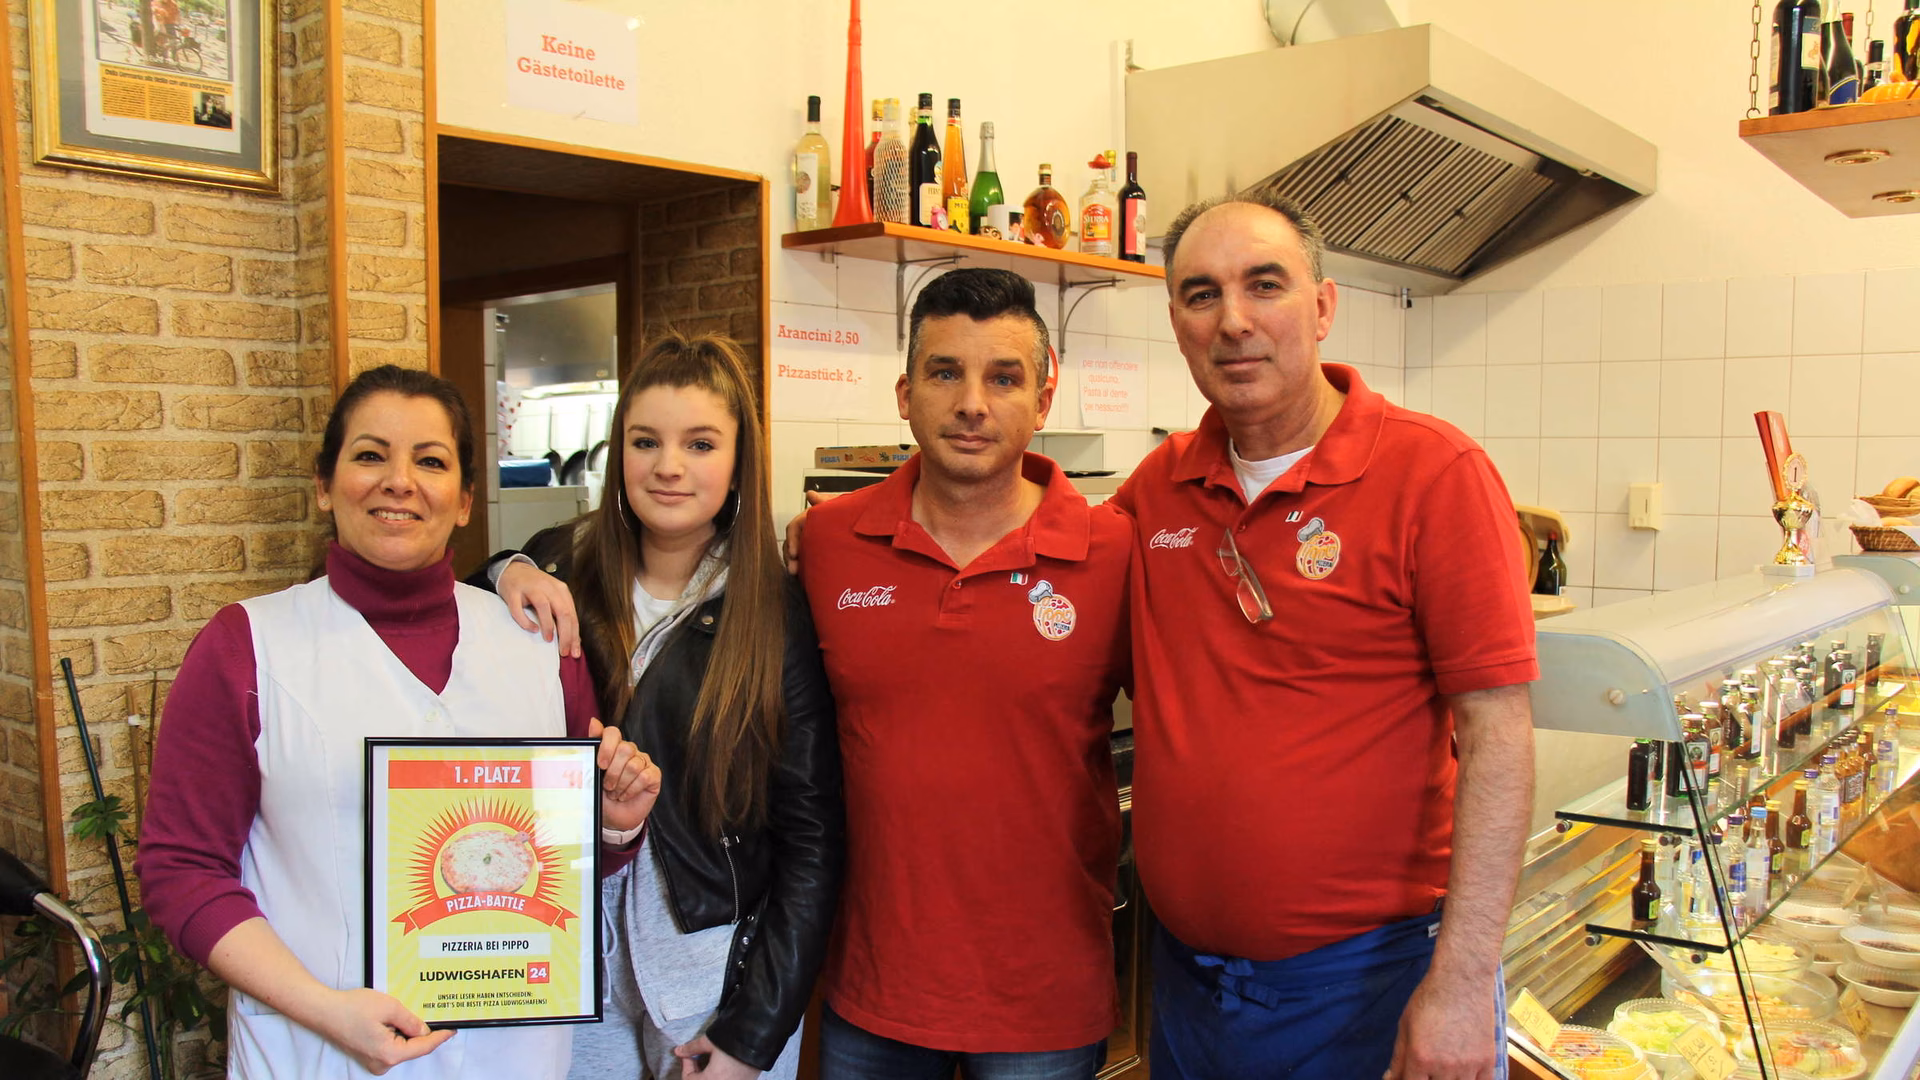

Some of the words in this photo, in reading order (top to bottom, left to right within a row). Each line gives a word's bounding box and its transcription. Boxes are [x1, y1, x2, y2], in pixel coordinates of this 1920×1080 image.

[541, 34, 596, 61] Keine
[517, 56, 626, 91] Gästetoilette
[778, 325, 832, 343] Arancini
[835, 331, 860, 345] 2,50
[778, 364, 844, 382] Pizzastück
[846, 370, 862, 385] 2,-
[1150, 526, 1199, 549] Coca-Cola
[837, 585, 898, 610] Coca-Cola
[454, 766, 468, 784] 1.
[474, 766, 522, 784] PLATZ
[446, 894, 526, 912] PIZZA-BATTLE
[442, 941, 483, 952] PIZZERIA
[486, 940, 499, 951] BEI
[502, 940, 529, 950] PIPPO
[420, 969, 525, 982] LUDWIGSHAFEN
[529, 966, 547, 979] 24
[501, 999, 548, 1007] LUDWIGSHAFENS!
